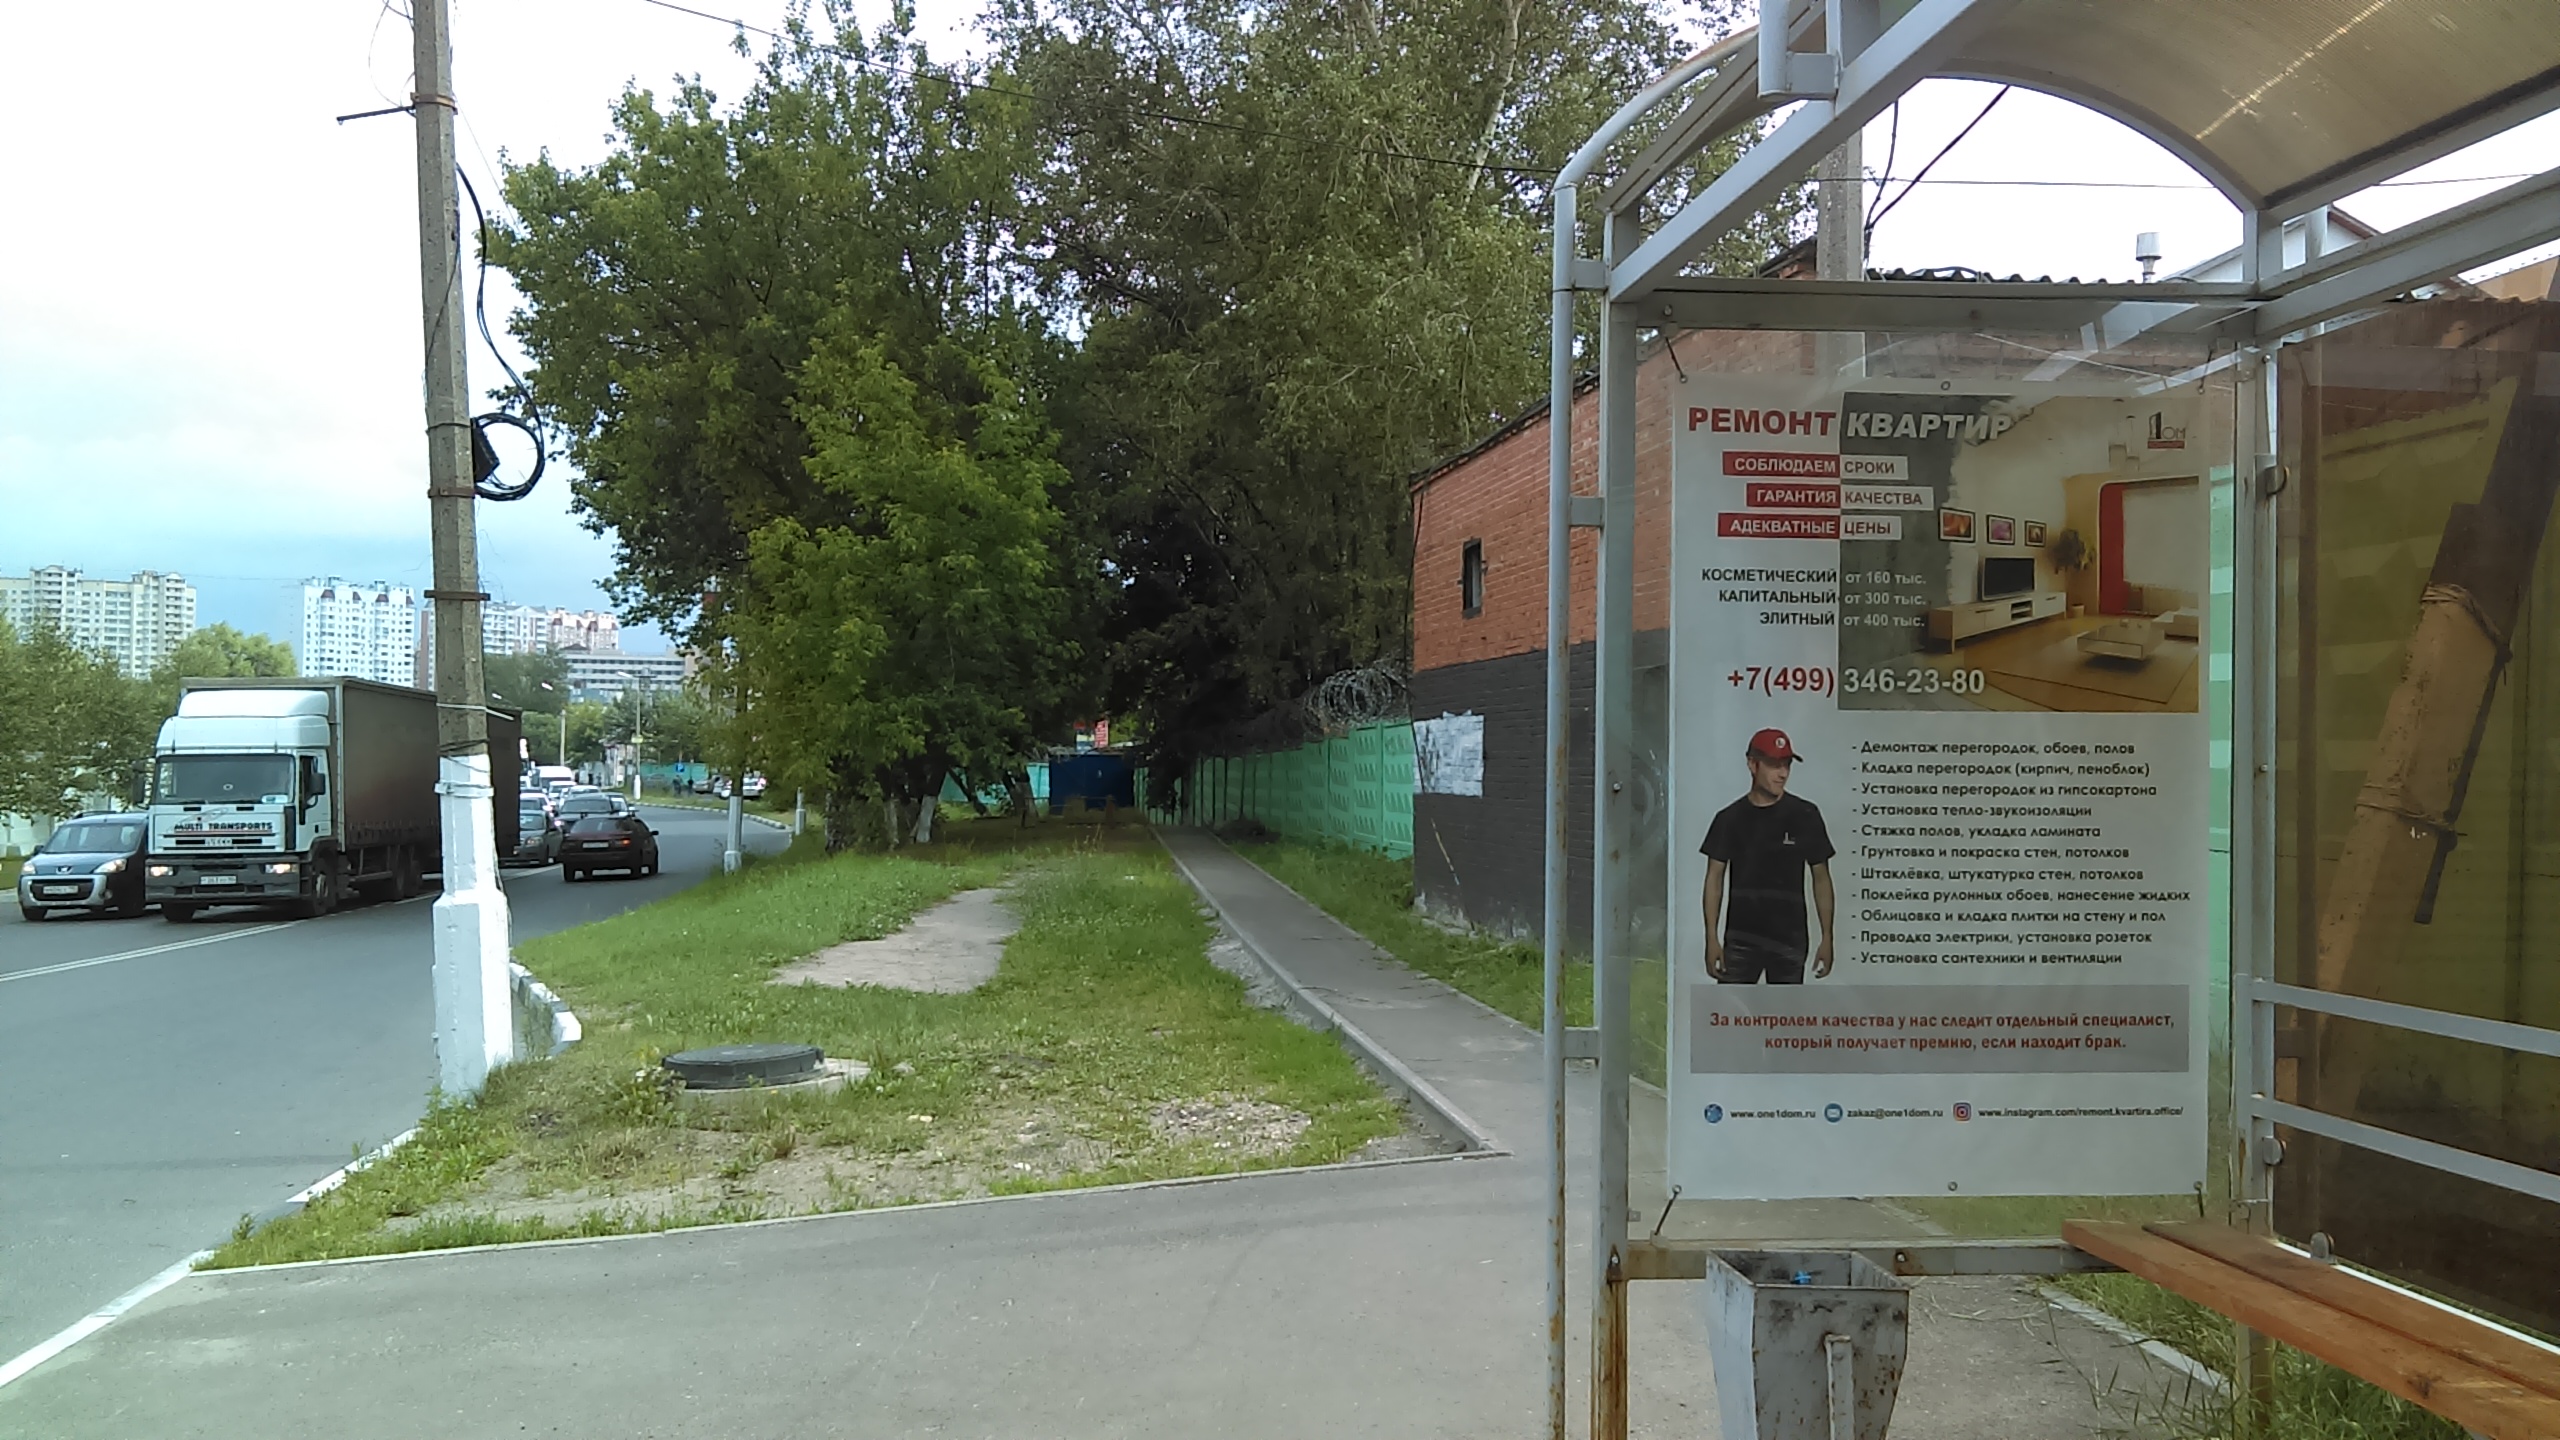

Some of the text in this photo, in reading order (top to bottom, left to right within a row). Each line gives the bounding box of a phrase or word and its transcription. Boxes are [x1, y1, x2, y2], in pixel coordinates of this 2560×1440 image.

[1688, 407, 2012, 441] РЕМОНТ КВАРТИР
[1734, 457, 1895, 475] СОБЛЮДАЕМ СРОКИ
[1756, 488, 1923, 506] ГАРАНТИЯ КАЧЕСТВА
[1730, 519, 1891, 537] АДЕКВАТНЫЕ ЦЕНЫ
[1702, 568, 1926, 585] КОСМЕТИЧЕСКИЙ от 160 тыс.
[1719, 589, 1926, 606] КАПИТАЛЬНЫЙ от 300 тыс.
[1759, 610, 1925, 627] ЭЛИТНЫЙ от 400 тыс.
[1727, 666, 1985, 698] +7(499) 346-23-80
[1861, 741, 1938, 754] Демонтаж
[1942, 744, 2039, 756] перегородок,
[2044, 742, 2090, 755] обоев,
[2095, 744, 2135, 754] полов
[1861, 762, 1913, 774] Кладка
[1917, 764, 2011, 776] перегородок
[2015, 762, 2073, 777] (кирпич,
[2078, 763, 2150, 777] пеноблок)
[1861, 782, 1938, 794] Установка
[1942, 785, 2036, 797] перегородок
[2040, 786, 2054, 796] из
[2058, 785, 2157, 797] гипсокартона
[1861, 803, 1938, 815] Установка
[1942, 806, 2092, 818] тепло-звукоизоляции
[208, 821, 273, 831] TRANSPORTS
[1861, 824, 1915, 836] Стяжка
[1919, 826, 1964, 838] полов,
[1969, 827, 2026, 839] укладка
[2030, 827, 2101, 837] ламината
[1861, 845, 1935, 859] Грунтовка
[1939, 848, 1947, 857] и
[1951, 848, 2020, 860] покраска
[2024, 848, 2061, 859] стен,
[2065, 848, 2129, 858] потолков
[1861, 867, 1944, 880] Штаклёвка,
[1948, 870, 2034, 882] штукатурка
[2039, 870, 2075, 881] стен,
[2079, 870, 2144, 880] потолков
[1861, 888, 1929, 901] Поклейка
[1933, 891, 2002, 903] рулонных
[2006, 889, 2053, 901] обоев,
[2057, 891, 2135, 901] нанесение
[2138, 891, 2191, 902] жидких
[1861, 909, 1941, 922] Облицовка
[1945, 912, 1953, 921] и
[1957, 912, 2007, 922] кладка
[2011, 912, 2058, 921] плитки
[2063, 912, 2080, 921] на
[2084, 912, 2125, 924] стену
[2129, 912, 2137, 921] и
[2141, 912, 2166, 922] пол
[1860, 930, 1931, 944] Проводка
[1935, 933, 2013, 945] электрики,
[2018, 933, 2092, 945] установка
[2095, 933, 2152, 945] розеток
[1860, 951, 1938, 964] Установка
[1941, 954, 2025, 964] сантехники
[2029, 954, 2037, 963] и
[2041, 954, 2122, 965] вентиляции
[1710, 1012, 2174, 1030] За контролем качества у нас следит отдельный специалист,
[1765, 1034, 2126, 1051] который получает премию, если находит брак.
[1730, 1107, 1816, 1119] www.one1dom.ru
[1847, 1106, 1943, 1120] zakaz@one1dom.ru
